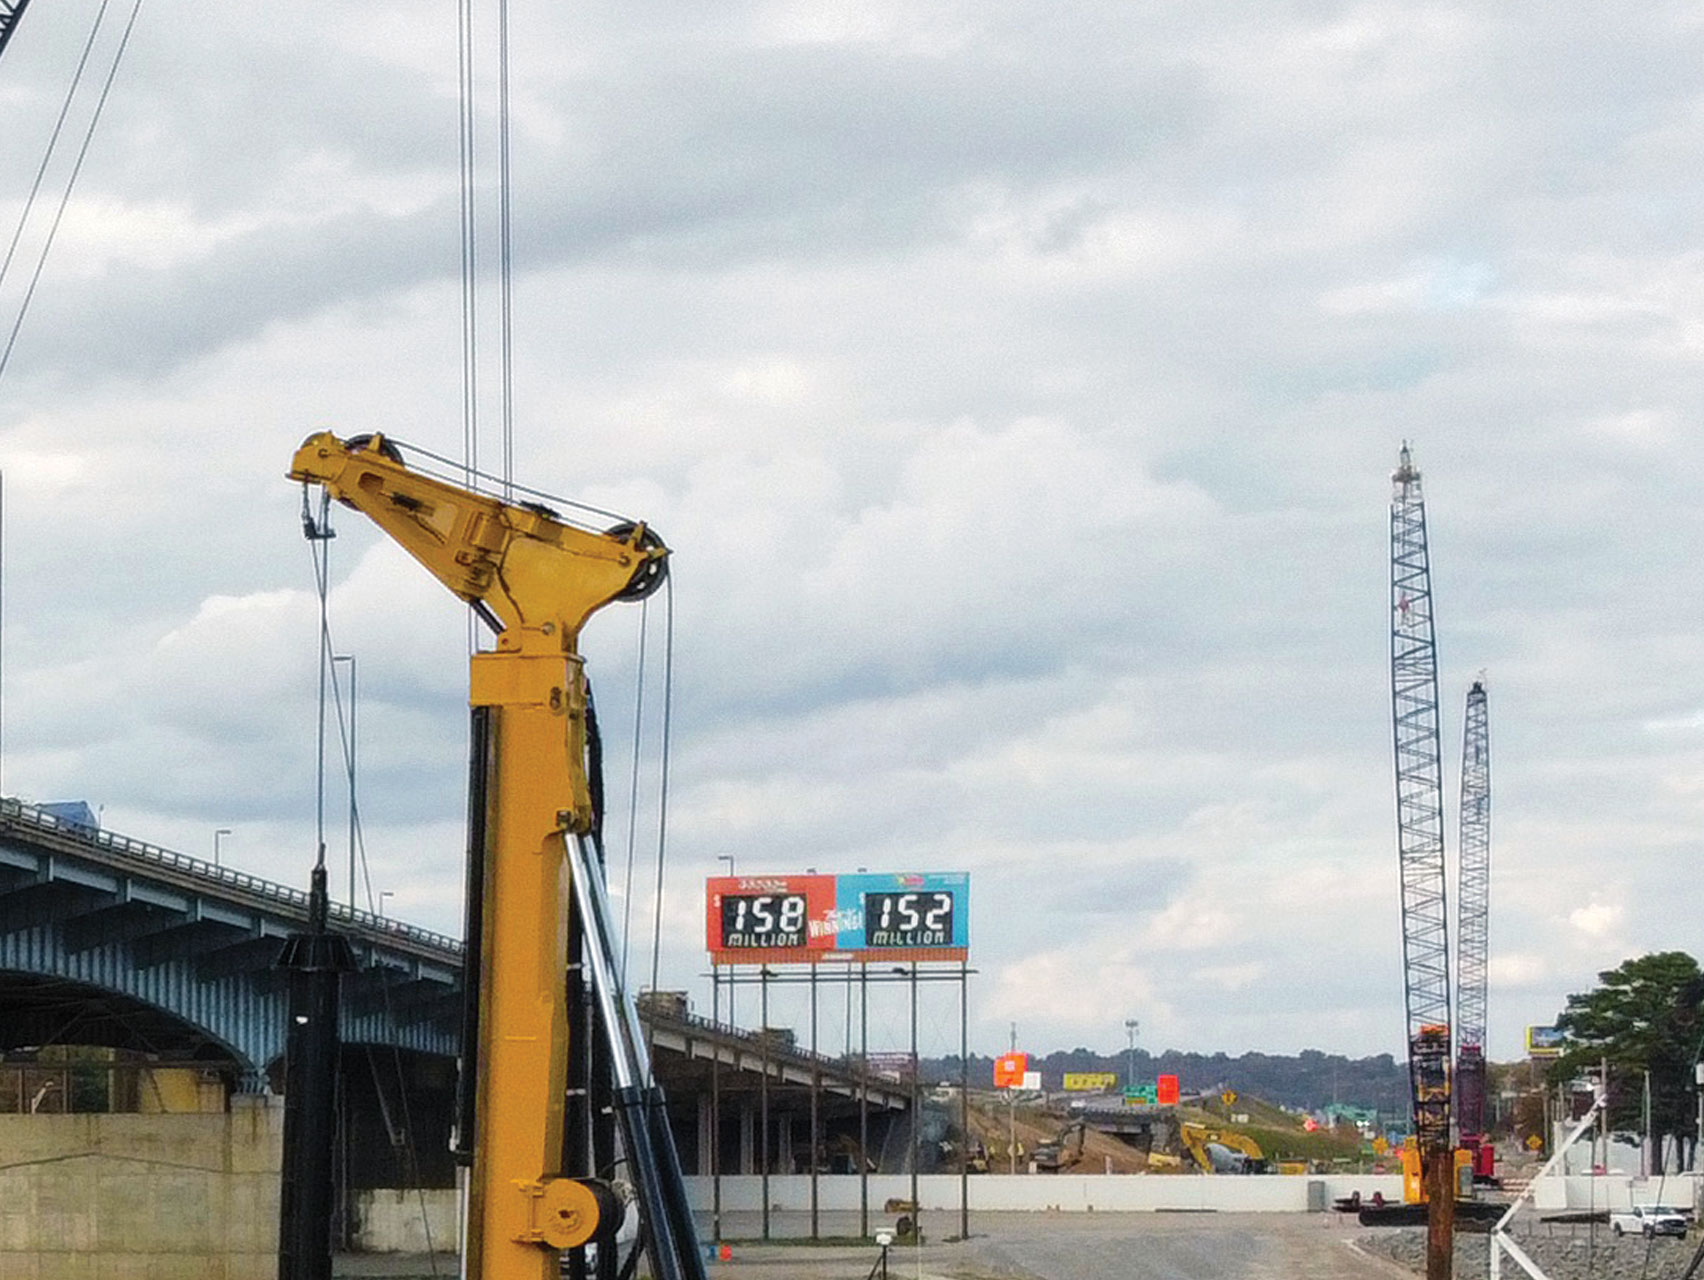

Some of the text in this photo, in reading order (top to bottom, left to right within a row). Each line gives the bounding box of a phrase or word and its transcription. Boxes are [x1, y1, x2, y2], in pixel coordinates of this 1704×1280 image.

[735, 896, 804, 933] 158
[880, 893, 951, 931] 152
[728, 933, 798, 947] MILLION
[873, 931, 945, 945] MILLION
